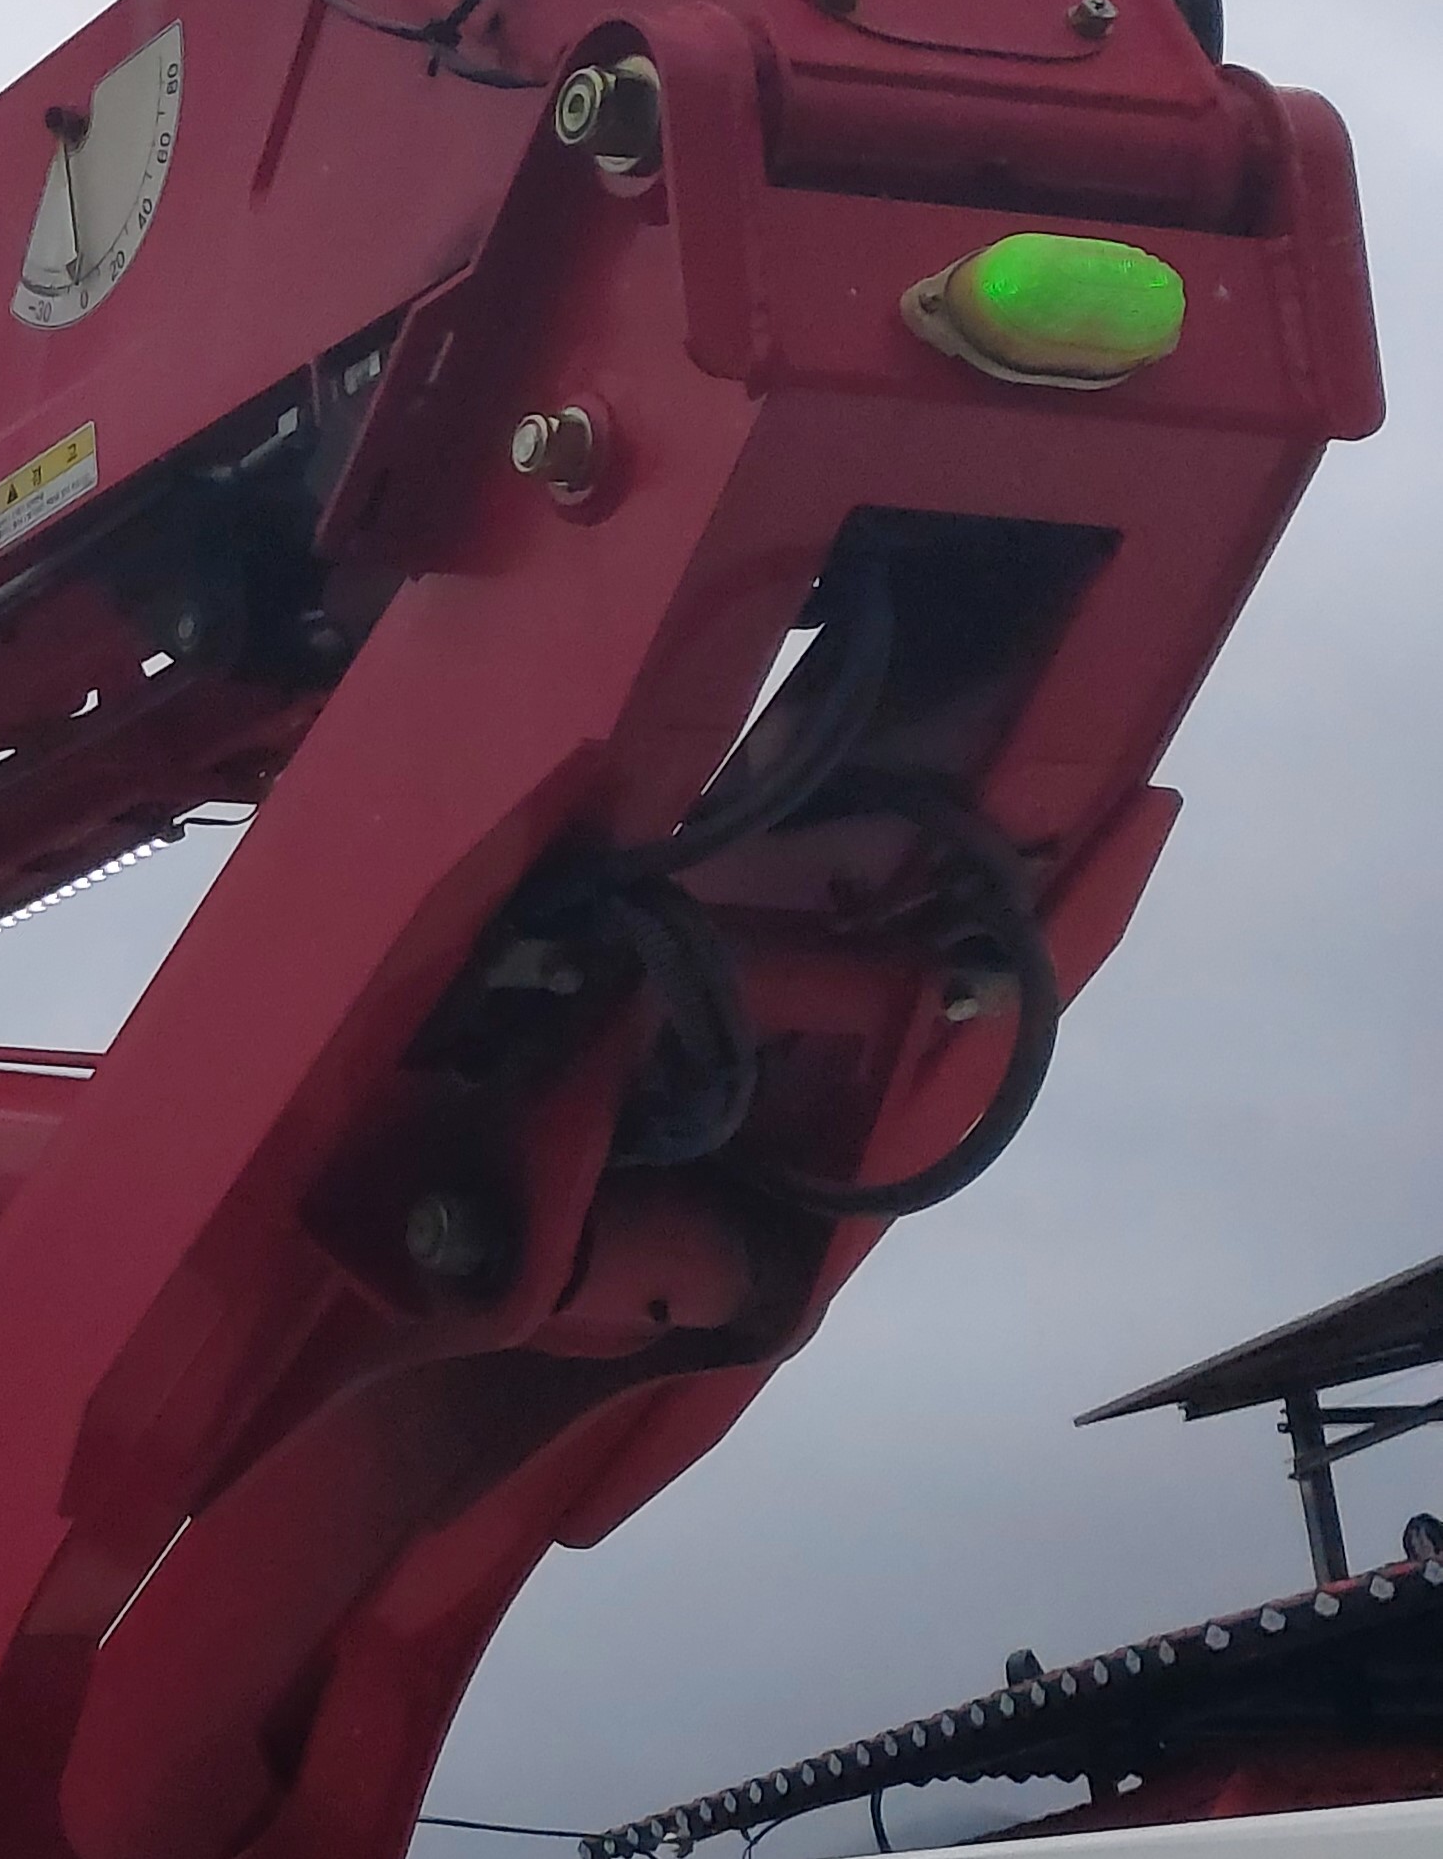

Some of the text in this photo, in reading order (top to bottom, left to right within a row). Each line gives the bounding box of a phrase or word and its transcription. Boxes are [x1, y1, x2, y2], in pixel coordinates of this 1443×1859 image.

[166, 63, 179, 95] 80
[157, 132, 171, 164] 60
[138, 198, 153, 230] 40
[110, 250, 126, 282] 20
[80, 290, 89, 309] 0
